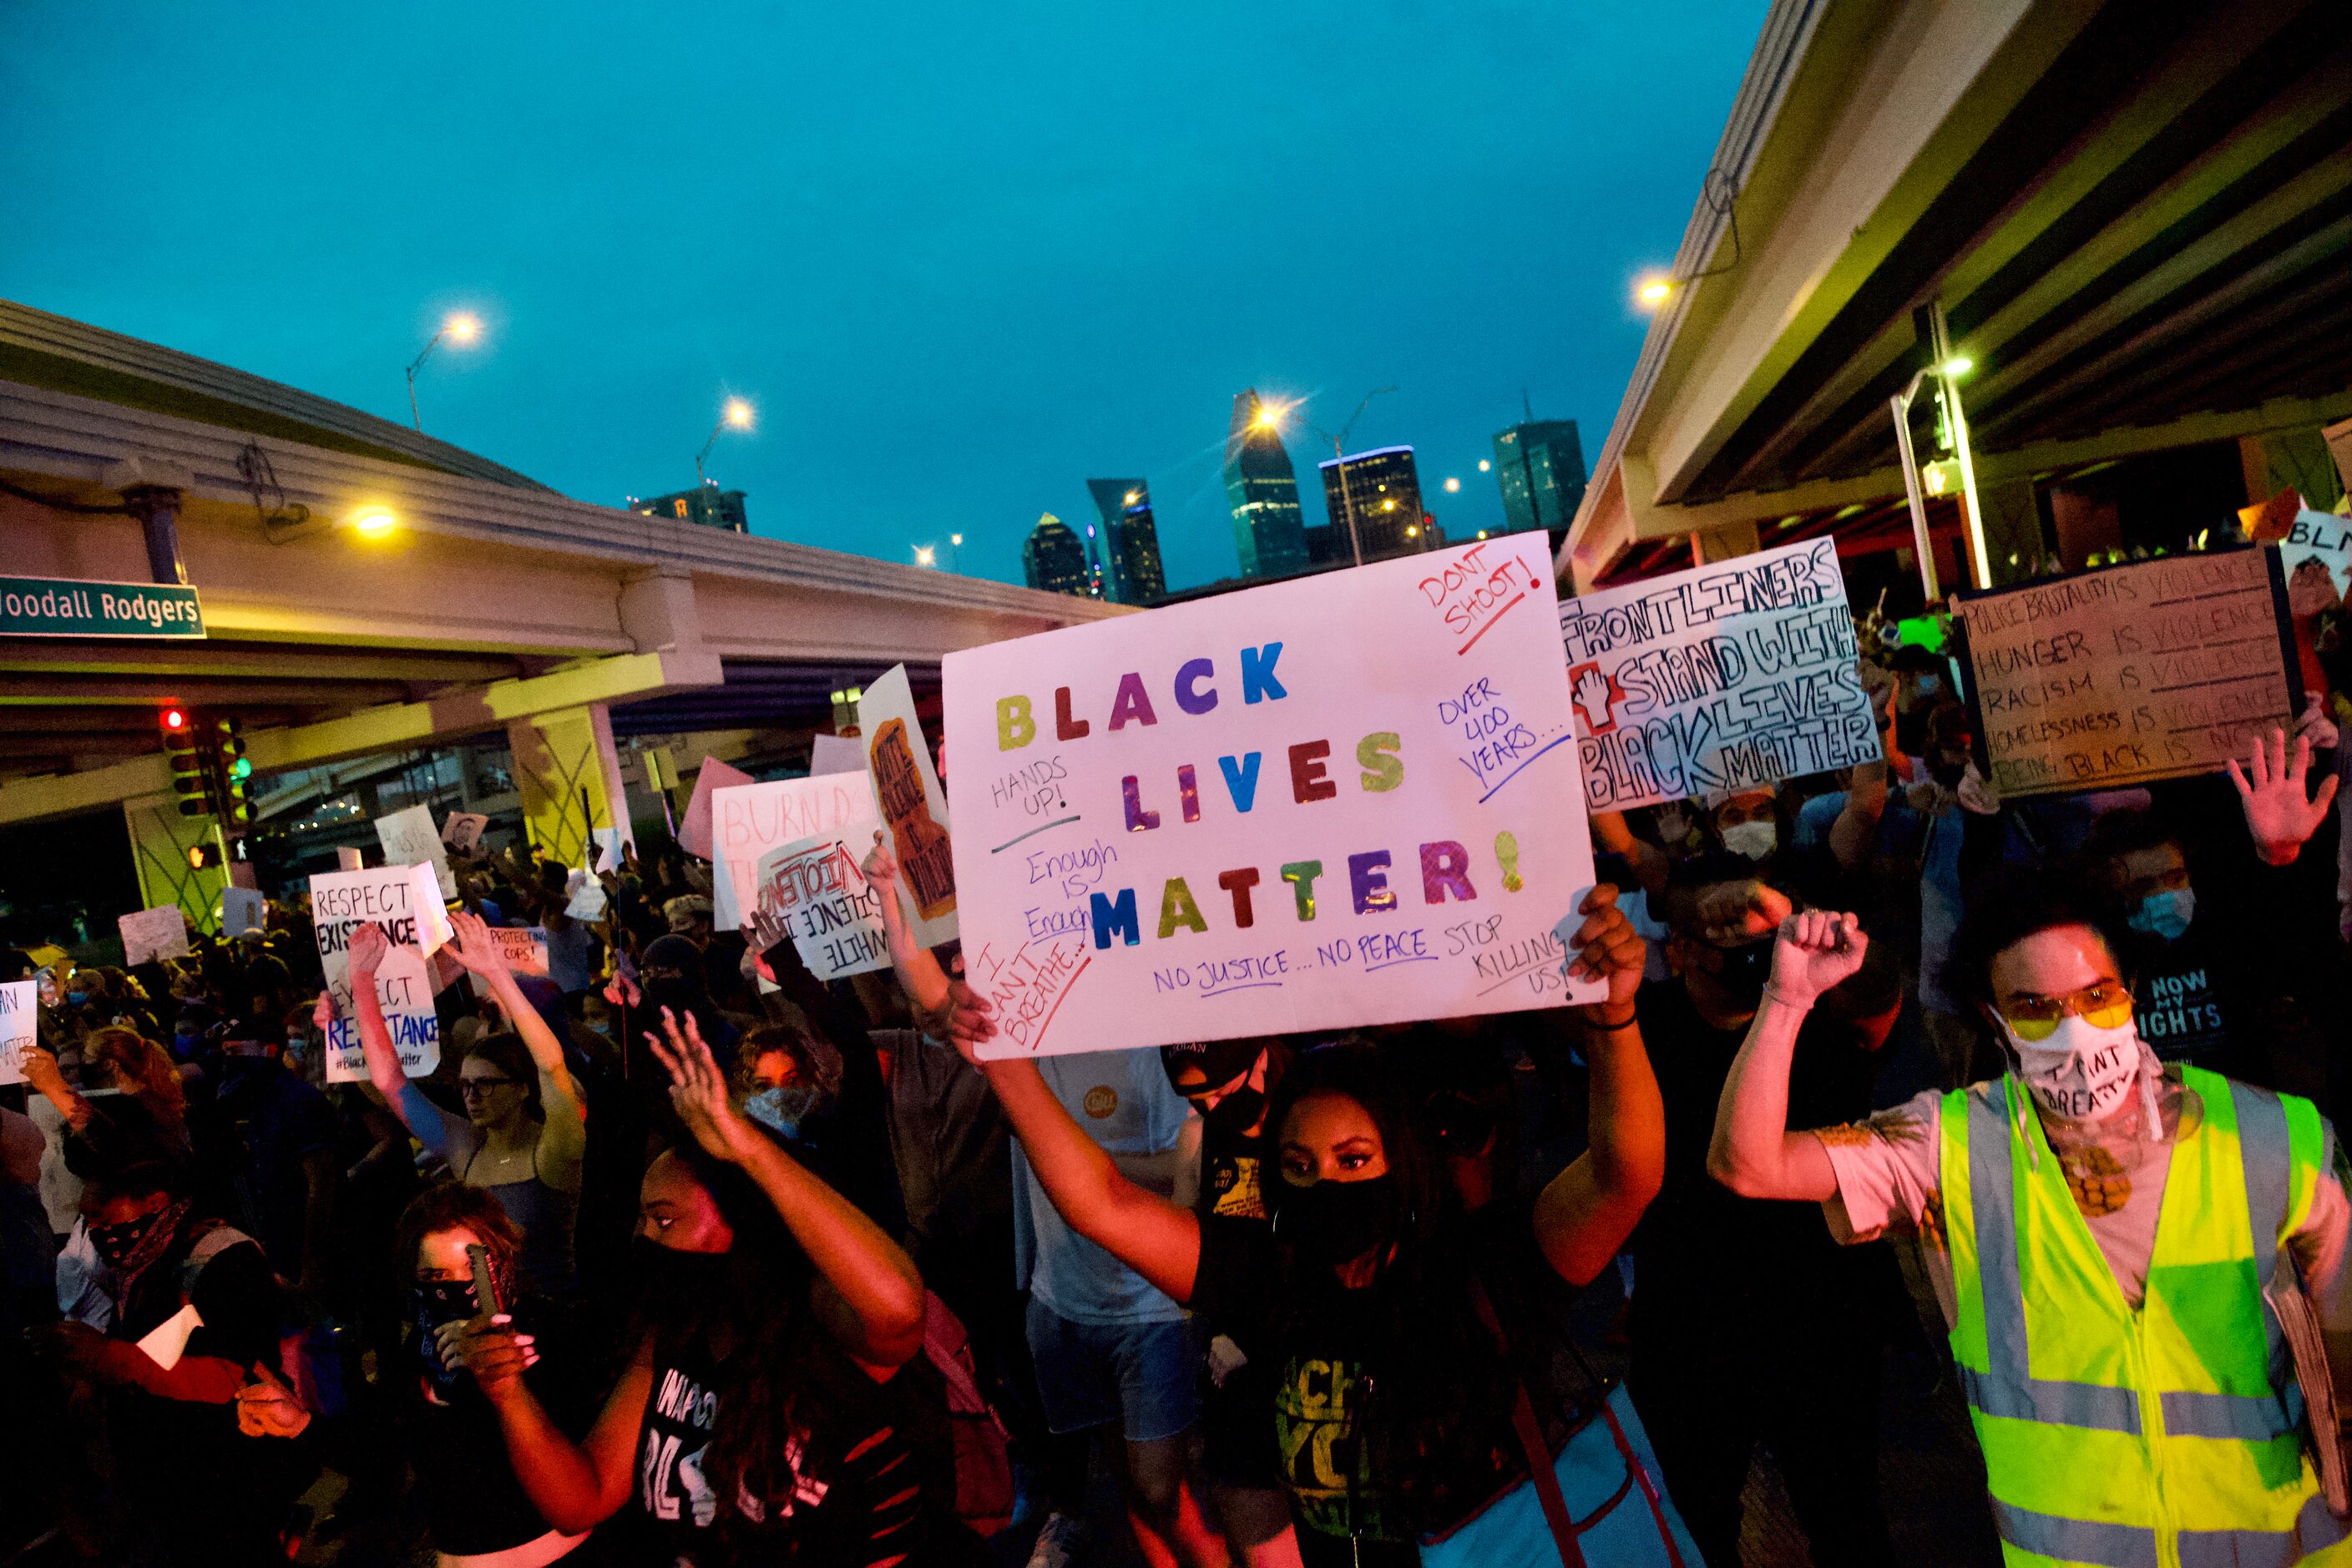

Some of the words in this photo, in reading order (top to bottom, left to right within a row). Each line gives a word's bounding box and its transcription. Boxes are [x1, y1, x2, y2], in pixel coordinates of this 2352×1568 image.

[1419, 544, 1485, 607] DONT
[1444, 555, 1540, 634] SHOOT!
[2027, 579, 2110, 621] BRUTALITY
[2111, 576, 2137, 603] IS
[2148, 559, 2265, 599] VIOLENCE
[0, 589, 92, 620] oodall
[101, 593, 198, 627] Rodgers
[1558, 539, 1842, 665] FRONTLINERS
[1616, 635, 1747, 715] STAND
[1747, 604, 1858, 674] WITH
[1976, 631, 2092, 680] HUNGER
[2113, 625, 2142, 655] IS
[2152, 600, 2275, 645] VIOLENCE
[995, 641, 1287, 751] BLACK
[1438, 677, 1500, 725] OVER
[1982, 673, 2093, 715] RACISM
[2120, 667, 2141, 690] IS
[2150, 641, 2279, 683] VIOLENCE
[1465, 706, 1509, 741] 400
[1577, 707, 1727, 808] BLACK
[1712, 660, 1867, 741] LIVES
[1987, 711, 2121, 756] HOMELESSNESS
[2132, 706, 2155, 733] IS
[1722, 714, 1877, 788] MATTER
[1992, 757, 2056, 790] BEING
[2065, 742, 2150, 776] BLACK
[2164, 740, 2192, 761] IS
[992, 756, 1067, 807] HANDS
[1024, 787, 1067, 817] UP!
[1122, 731, 1404, 832] LIVES
[725, 790, 820, 847] BURN
[1026, 838, 1117, 884] Enough
[316, 883, 410, 917] RESPECT
[802, 884, 882, 938] SILENCE
[1062, 876, 1088, 900] IS
[1090, 830, 1524, 949] MATTER!
[316, 916, 419, 956] EXISNCE
[504, 945, 534, 961] COPS!
[823, 928, 888, 973] WHITE
[1444, 914, 1502, 957] STOP
[1472, 931, 1568, 979] KILLING
[978, 942, 1004, 980] I
[1154, 968, 1190, 993] NO
[1318, 938, 1352, 967] NO
[1358, 929, 1427, 964] PEACE
[1528, 967, 1572, 1001] US!
[331, 975, 413, 1009] EXECT
[327, 1014, 440, 1050] RETANCE
[2139, 1004, 2221, 1039] IGHTS
